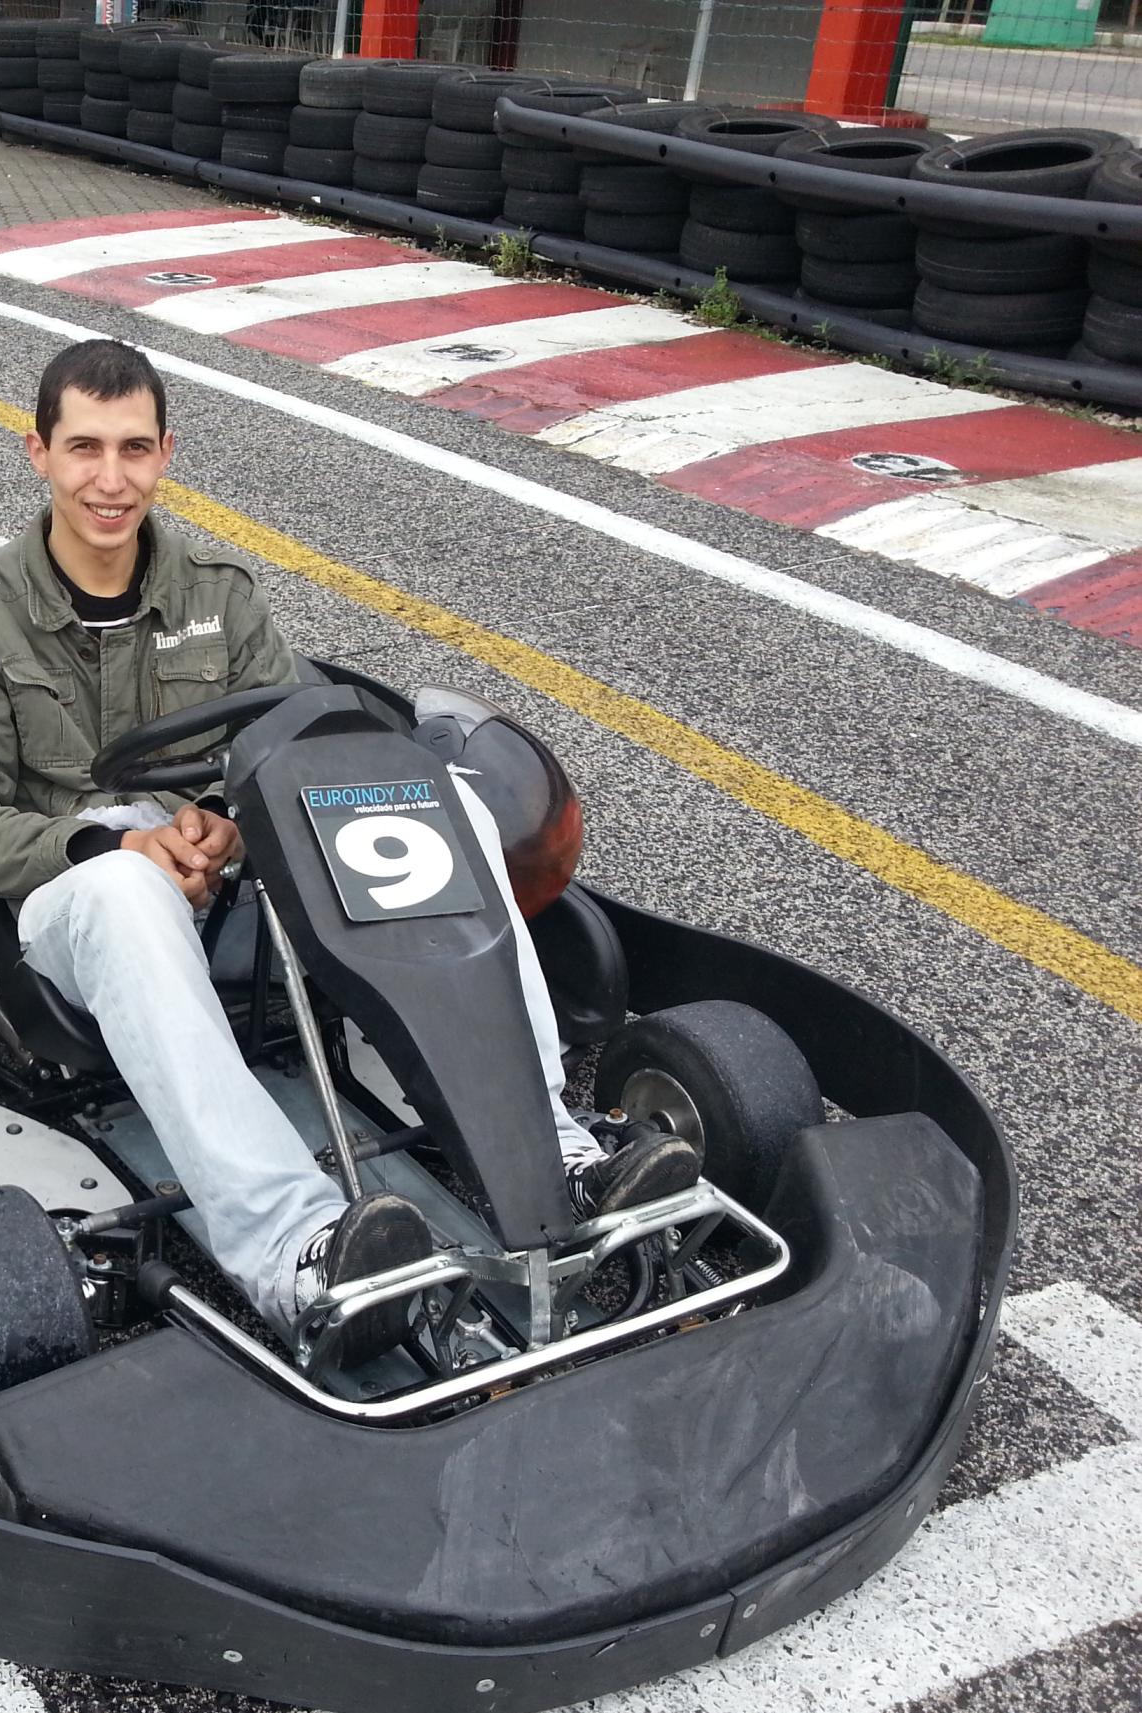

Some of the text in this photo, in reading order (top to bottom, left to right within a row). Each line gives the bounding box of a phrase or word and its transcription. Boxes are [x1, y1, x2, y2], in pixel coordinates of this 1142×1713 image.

[309, 783, 431, 807] EUROINDY XXI
[354, 803, 393, 814] velocidade
[394, 803, 410, 812] para
[418, 801, 439, 809] futuro
[335, 815, 453, 909] 9
